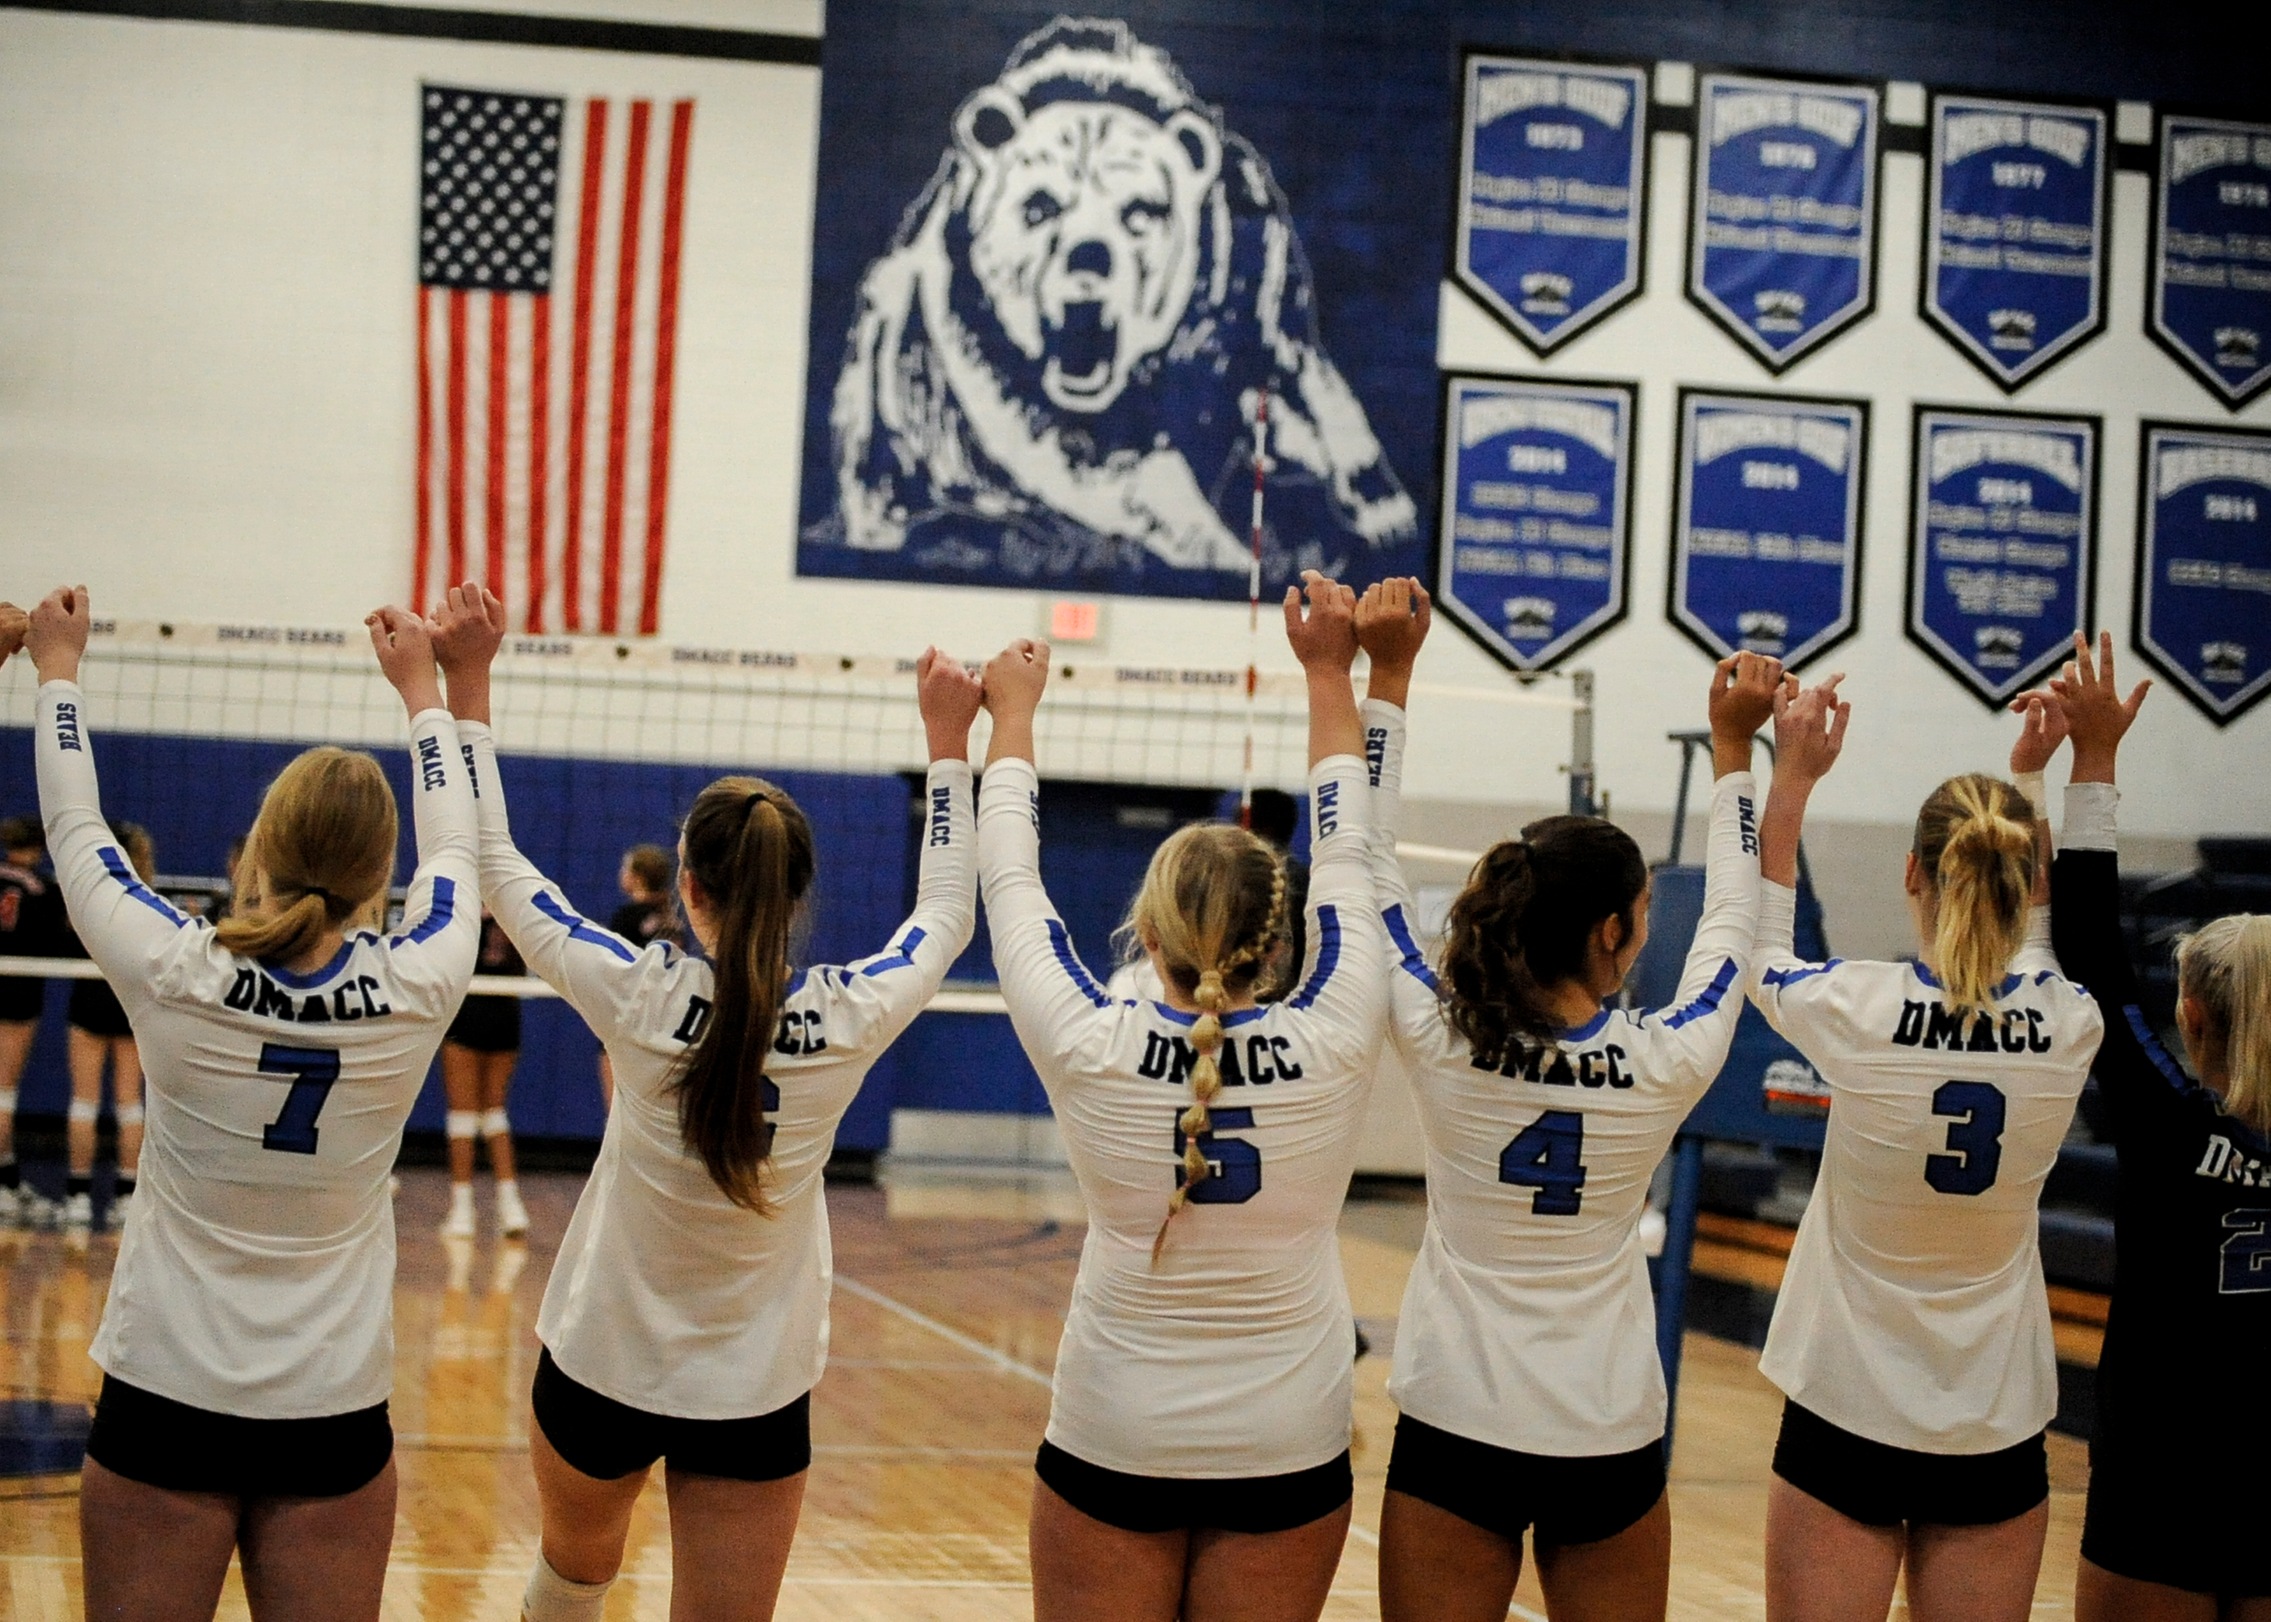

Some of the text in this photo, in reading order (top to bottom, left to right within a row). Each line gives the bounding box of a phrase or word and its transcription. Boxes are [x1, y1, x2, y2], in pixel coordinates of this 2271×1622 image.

[286, 629, 345, 646] BEARS
[57, 702, 82, 752] BEARS
[418, 735, 446, 792] DMACC
[931, 787, 950, 847] DMACC
[1738, 795, 1758, 856] DMACC
[224, 968, 392, 1022] DMACC
[672, 994, 828, 1056] DCC
[1892, 998, 2052, 1053] DMACC
[258, 1042, 341, 1155] 7
[1173, 1106, 1262, 1204] 5
[1499, 1109, 1587, 1215] 4
[1924, 1080, 2006, 1196] 3
